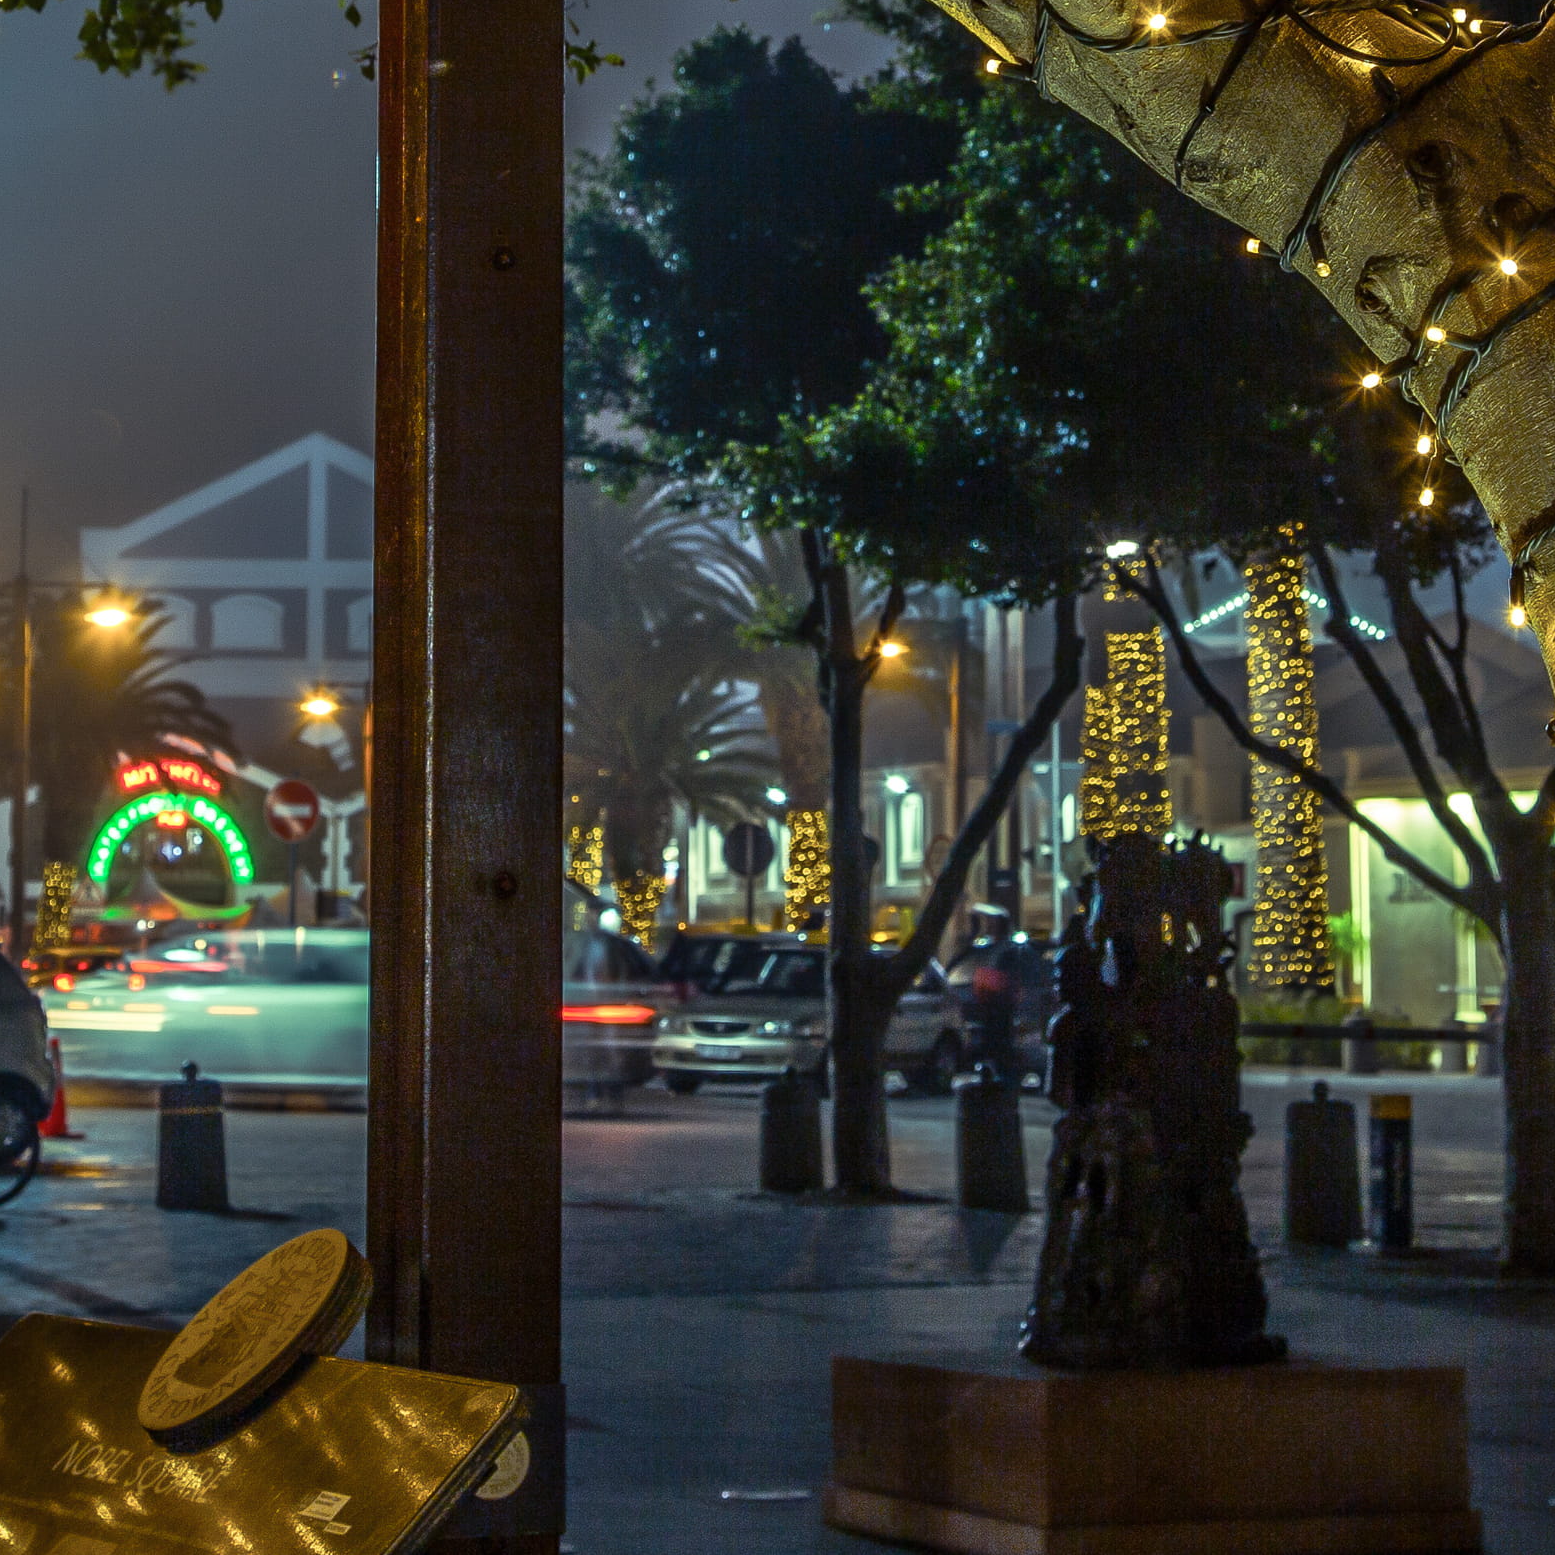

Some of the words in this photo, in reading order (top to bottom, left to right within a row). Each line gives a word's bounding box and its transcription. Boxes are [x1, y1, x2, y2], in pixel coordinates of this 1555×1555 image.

[158, 1371, 240, 1419] TOWN
[52, 1440, 133, 1485] NOBEL
[124, 1456, 230, 1504] SQUARE
